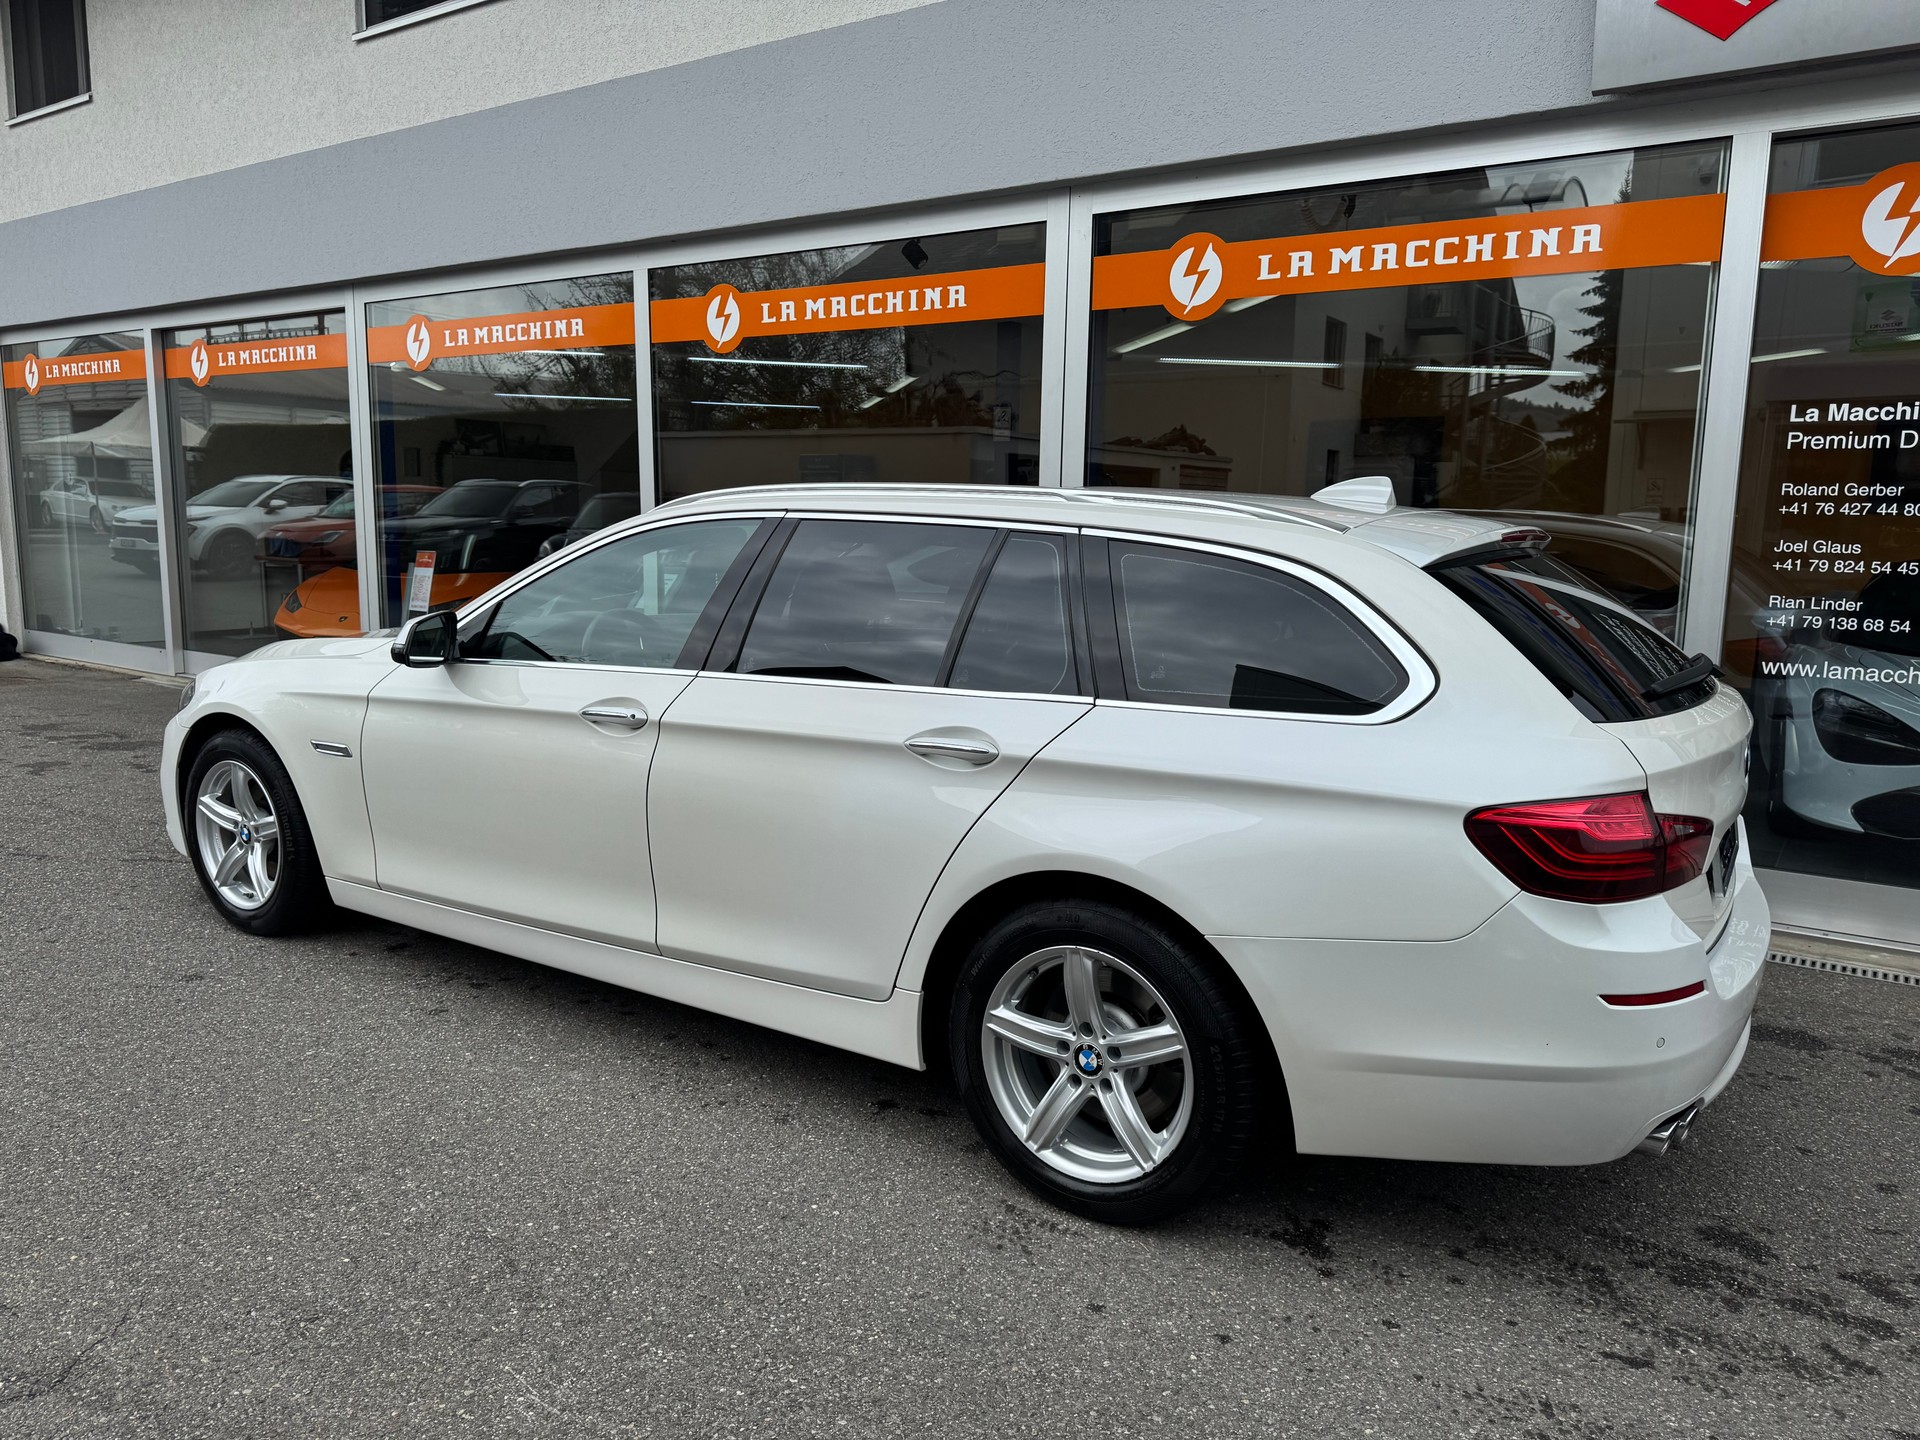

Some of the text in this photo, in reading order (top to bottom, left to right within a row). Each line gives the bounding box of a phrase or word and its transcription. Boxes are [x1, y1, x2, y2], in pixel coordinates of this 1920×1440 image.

[1256, 223, 1605, 281] LA MACCHINA
[761, 284, 967, 324] LA MACCHINA
[444, 317, 585, 348] LA MACCHINA
[217, 343, 317, 367] LA MACCHINA
[45, 359, 121, 379] LA MACCHINA
[1789, 401, 1920, 422] La Macchi
[1787, 430, 1891, 450] Premium
[1781, 483, 1905, 496] Roland Gerber
[1778, 502, 1808, 515] +41
[1815, 502, 1835, 516] 76
[1839, 502, 1872, 516] 427
[1876, 502, 1898, 516] 44
[1773, 539, 1862, 555] Joel Glaus
[1772, 558, 1919, 576] +41 79 824 54 45
[1768, 595, 1864, 612] Rian Linder
[1766, 614, 1912, 634] +41 79 138 68 54
